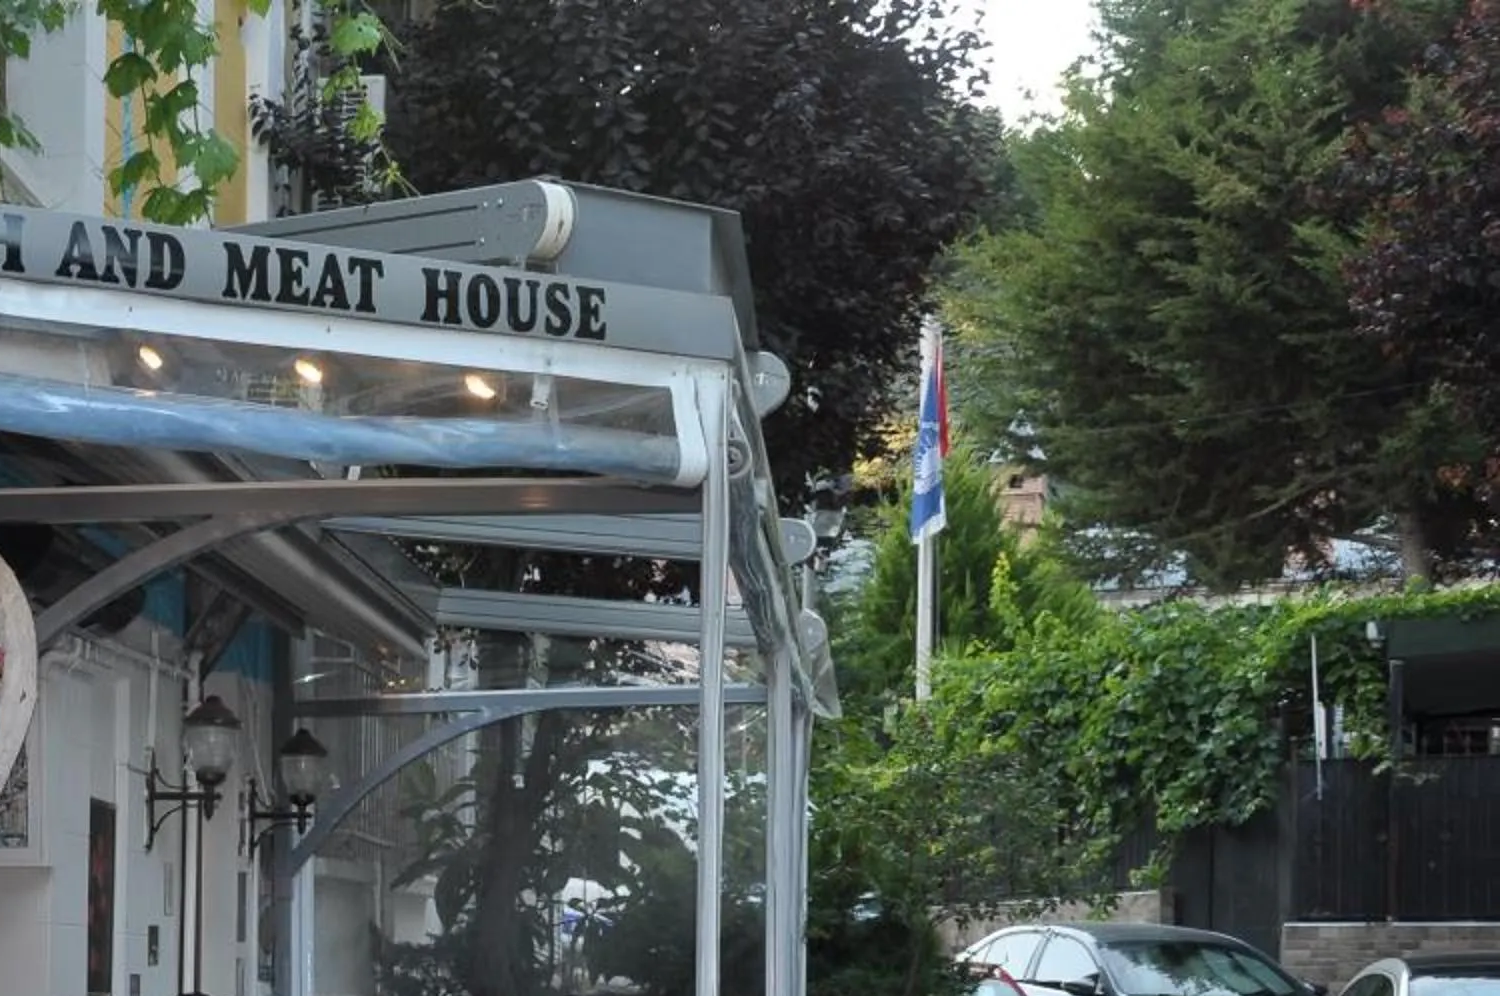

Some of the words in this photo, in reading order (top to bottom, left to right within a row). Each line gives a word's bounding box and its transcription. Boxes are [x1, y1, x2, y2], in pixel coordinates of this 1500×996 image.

[55, 220, 187, 291] AND
[222, 241, 385, 313] MEAT
[421, 267, 607, 341] HOUSE
